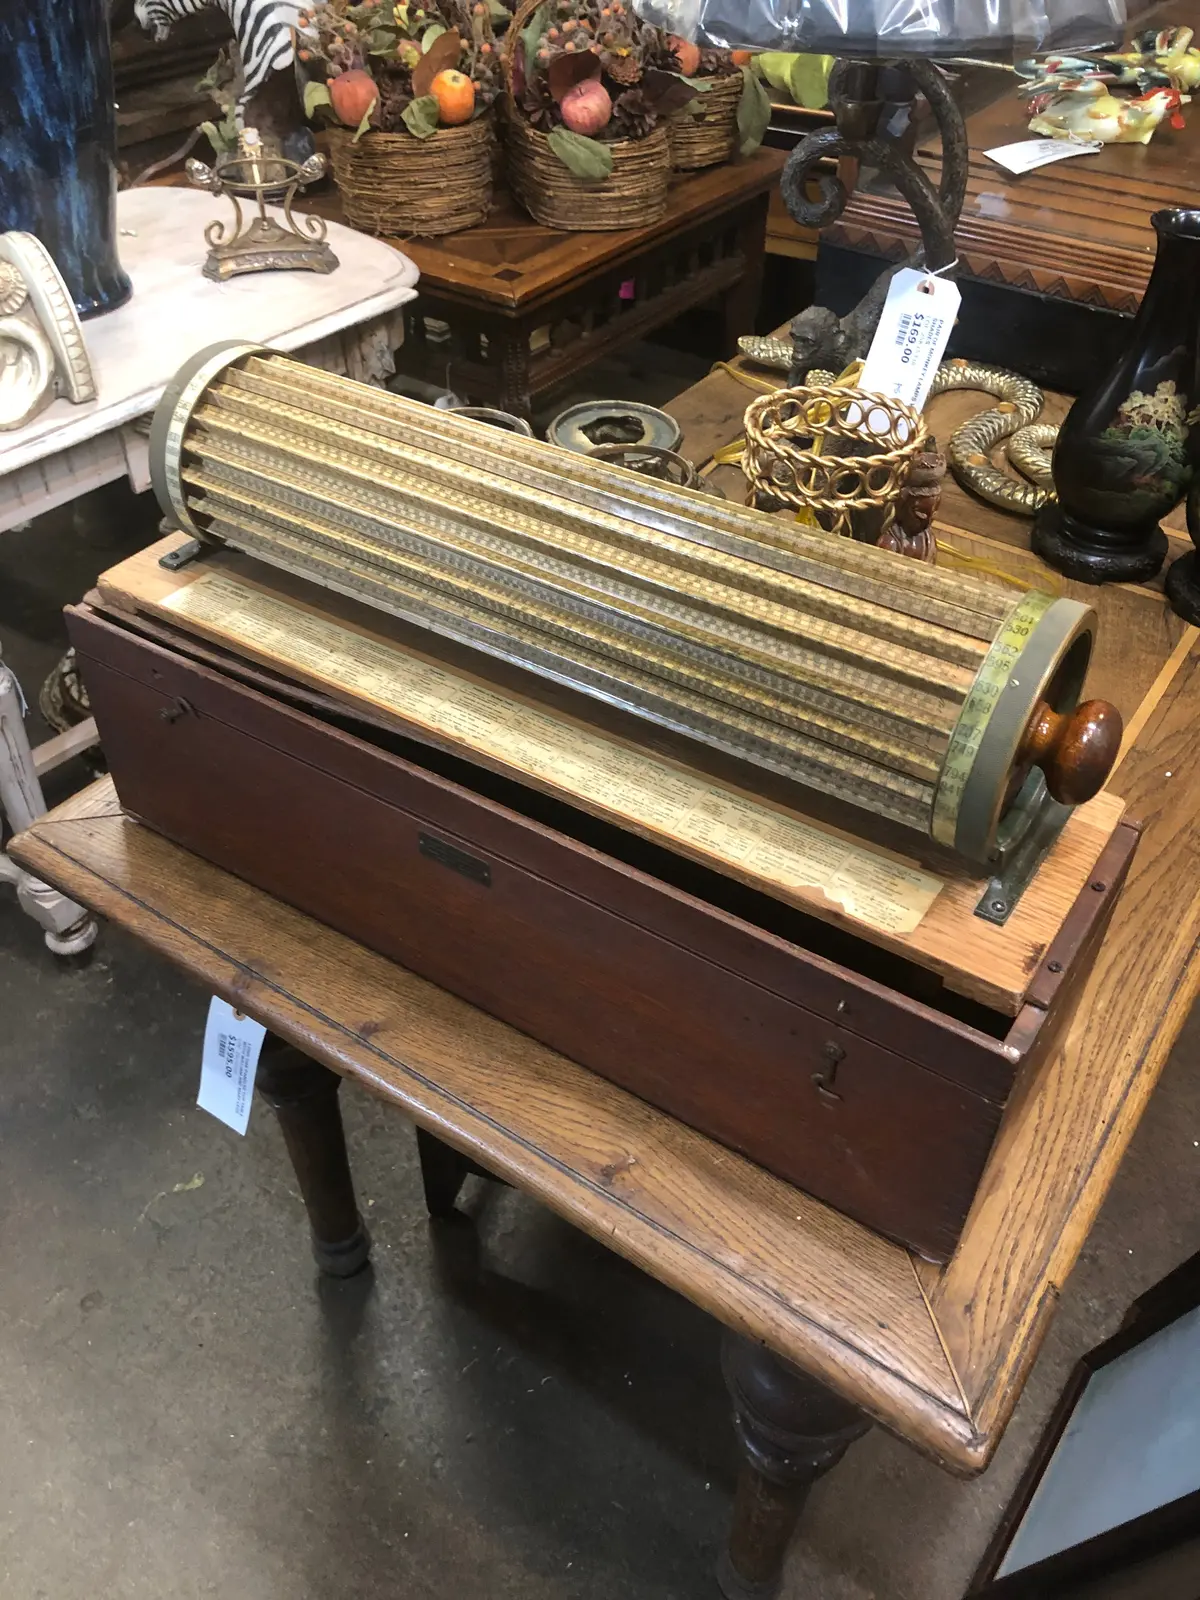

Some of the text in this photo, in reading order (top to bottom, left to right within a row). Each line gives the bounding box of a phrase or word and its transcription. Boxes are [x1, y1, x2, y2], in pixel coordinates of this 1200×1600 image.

[900, 312, 925, 364] $169.00
[1005, 622, 1029, 637] 530
[987, 656, 1011, 672] 595
[225, 1034, 237, 1078] $1595.00
